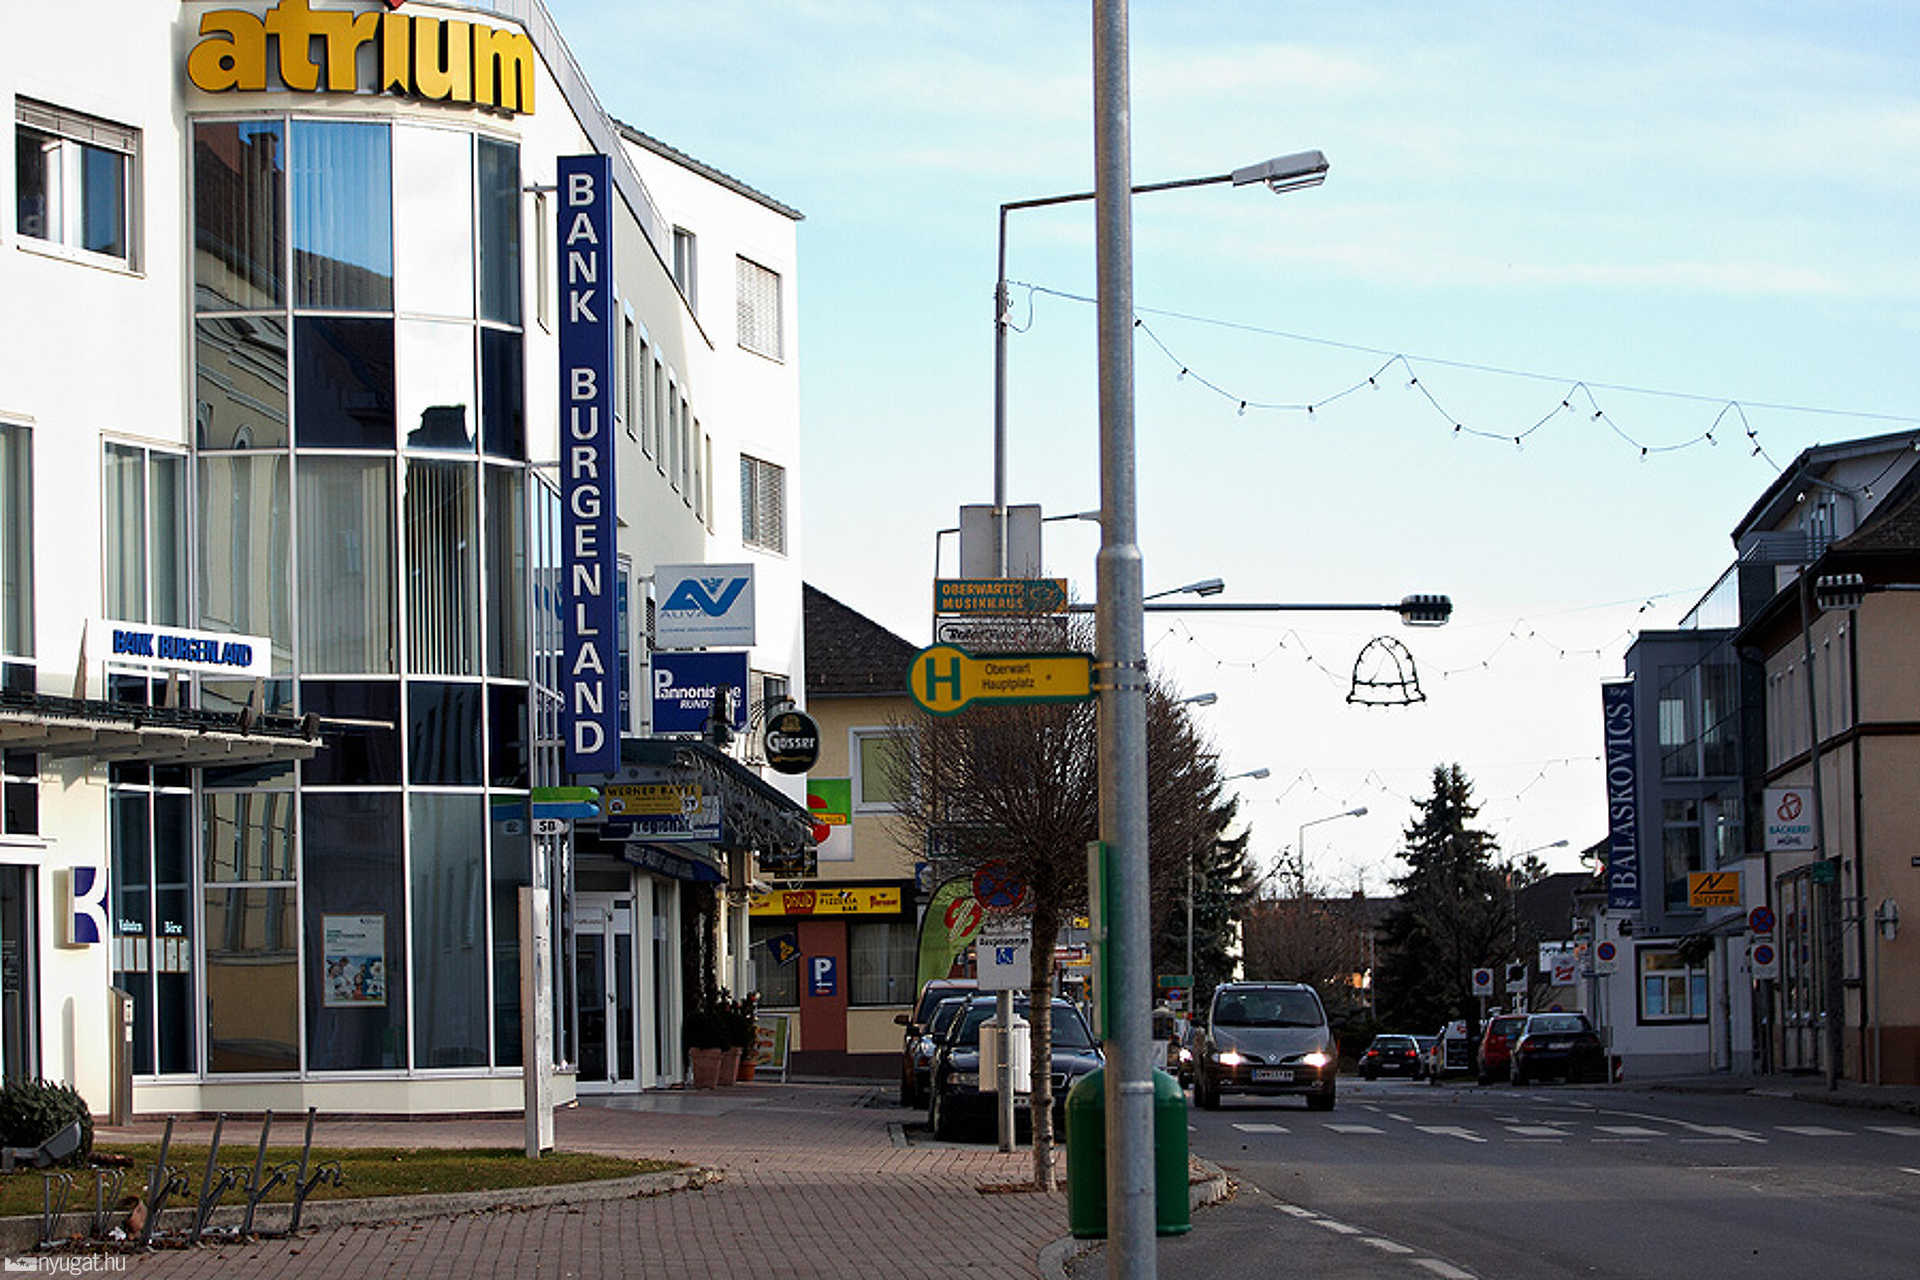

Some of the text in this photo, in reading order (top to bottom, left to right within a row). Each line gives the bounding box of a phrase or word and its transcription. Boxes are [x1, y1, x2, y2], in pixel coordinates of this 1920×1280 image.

[187, 0, 536, 116] atrium
[566, 173, 606, 755] BANK BURGENLAND
[112, 629, 253, 667] BANK BURGENLAND
[925, 657, 961, 701] H
[981, 677, 1035, 693] Hauptplatz
[984, 662, 1031, 676] Oberwart
[1606, 703, 1638, 890] BALASKOVICS
[814, 957, 832, 981] P
